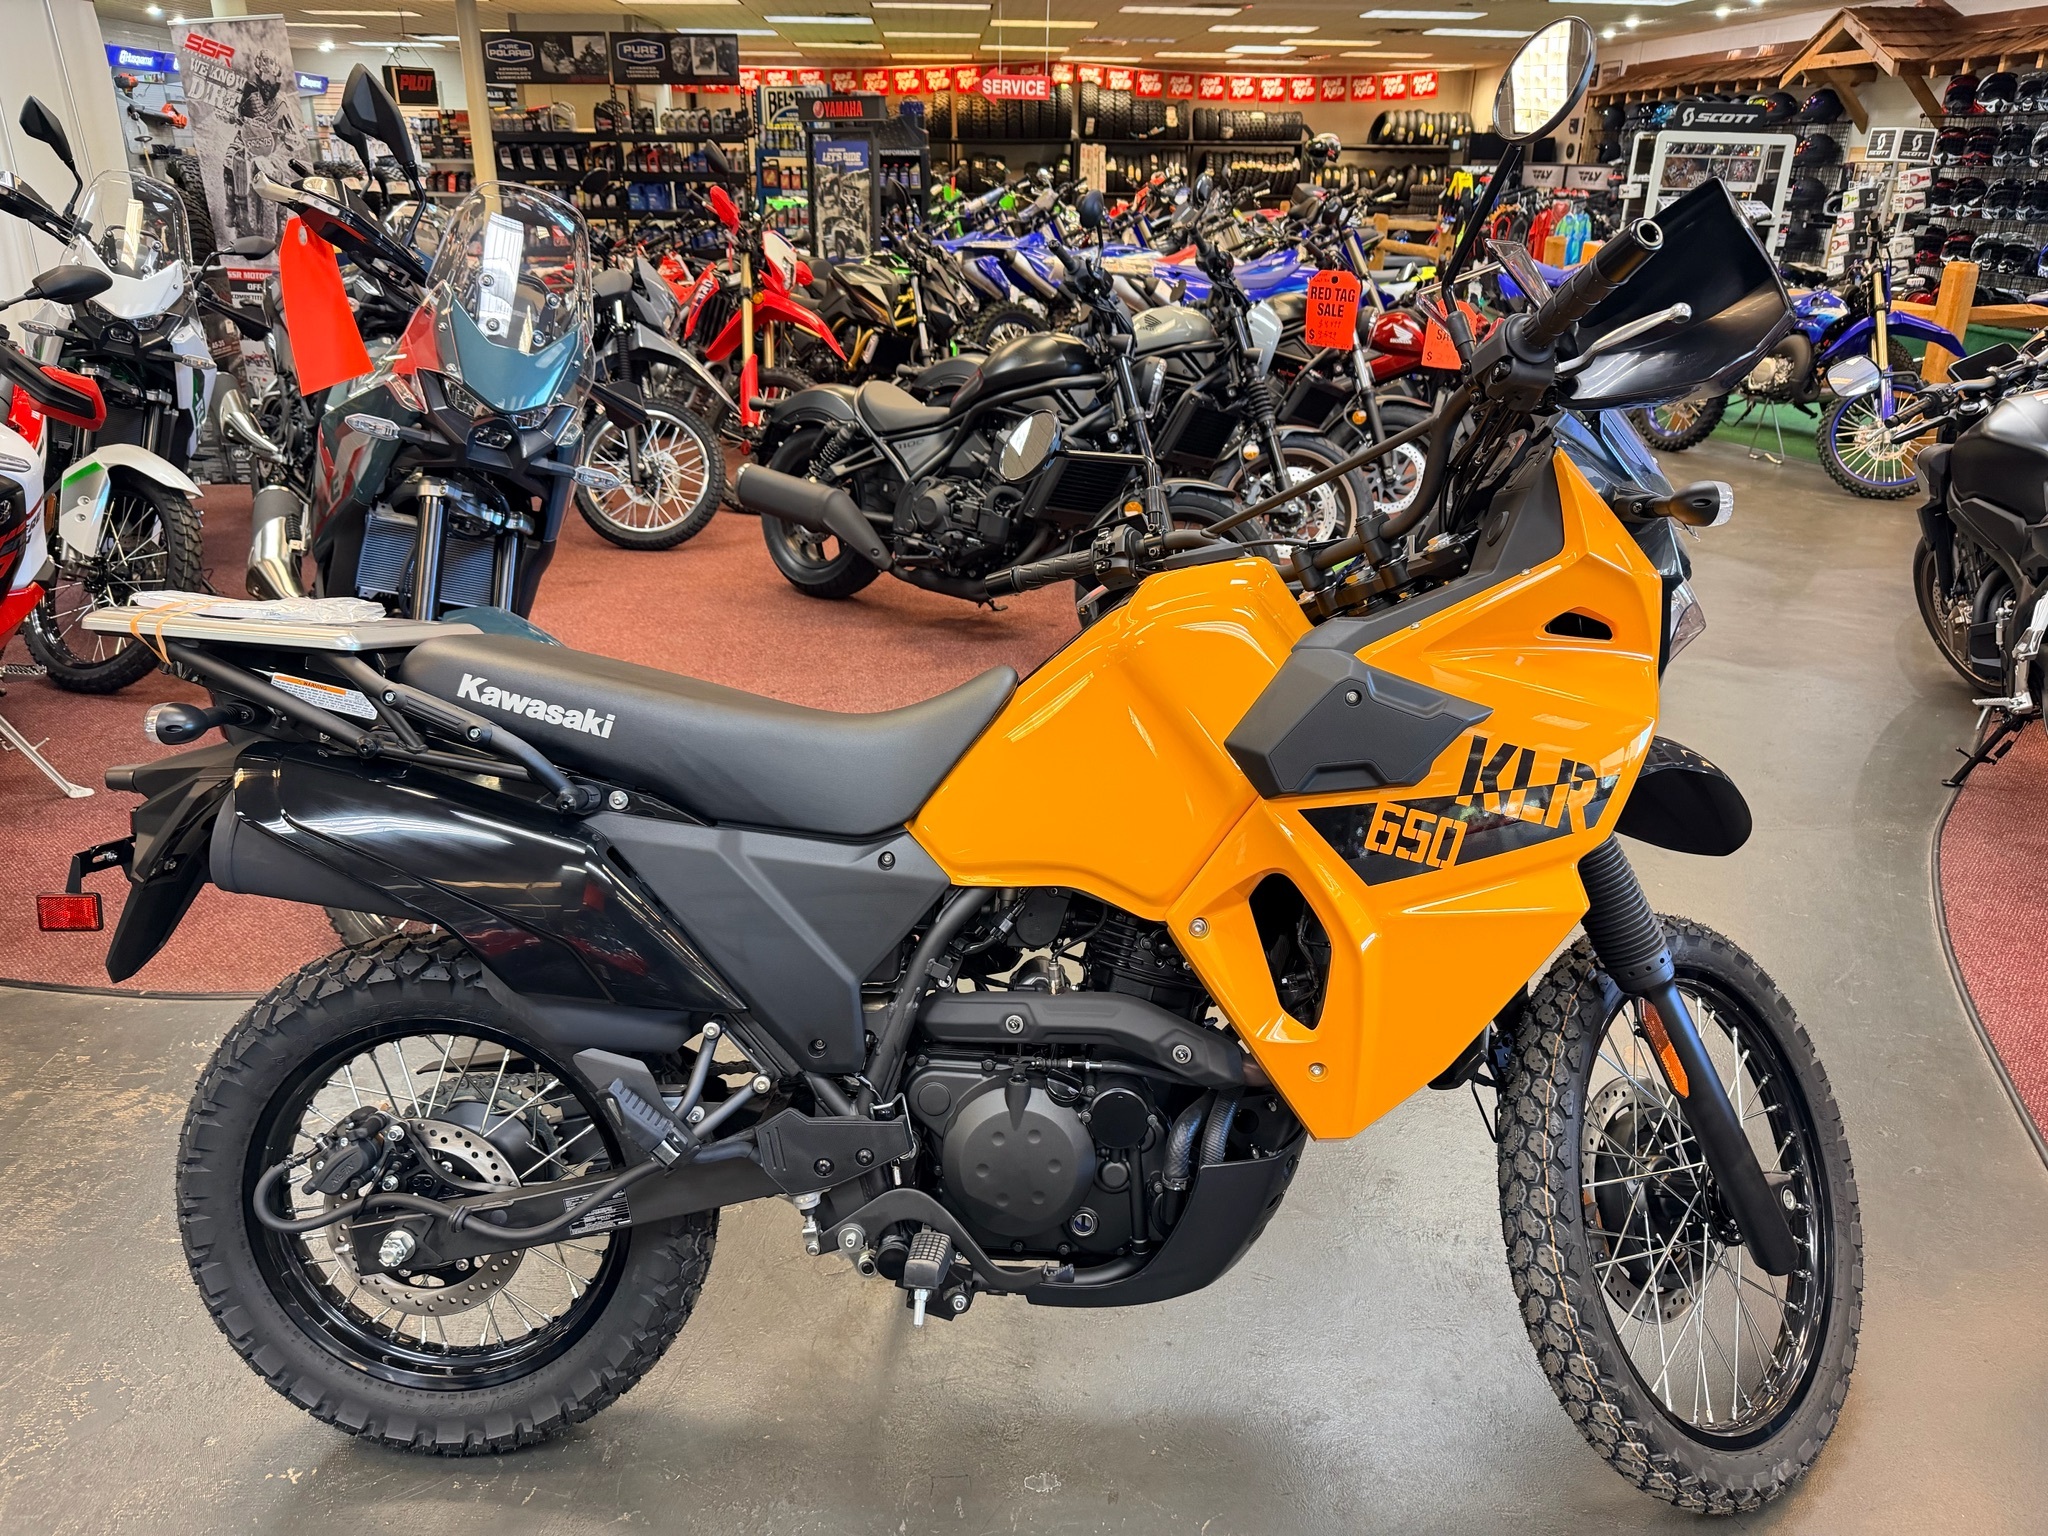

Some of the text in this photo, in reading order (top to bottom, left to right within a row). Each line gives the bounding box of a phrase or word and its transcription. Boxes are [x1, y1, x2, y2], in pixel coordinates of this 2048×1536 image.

[185, 33, 235, 68] SSR
[489, 49, 532, 57] POLARIS
[623, 45, 659, 54] PURE
[190, 57, 209, 77] WE
[209, 65, 248, 92] KNOW
[400, 73, 433, 92] PILOT
[982, 78, 1046, 96] SERVICE
[823, 100, 864, 118] YAMAHA
[1694, 112, 1759, 124] SCOTT
[1310, 286, 1356, 302] RED TAG
[1317, 302, 1344, 318] SALE
[456, 673, 616, 739] Kawasaki
[1454, 734, 1597, 832] KLR
[1364, 800, 1468, 868] 650
